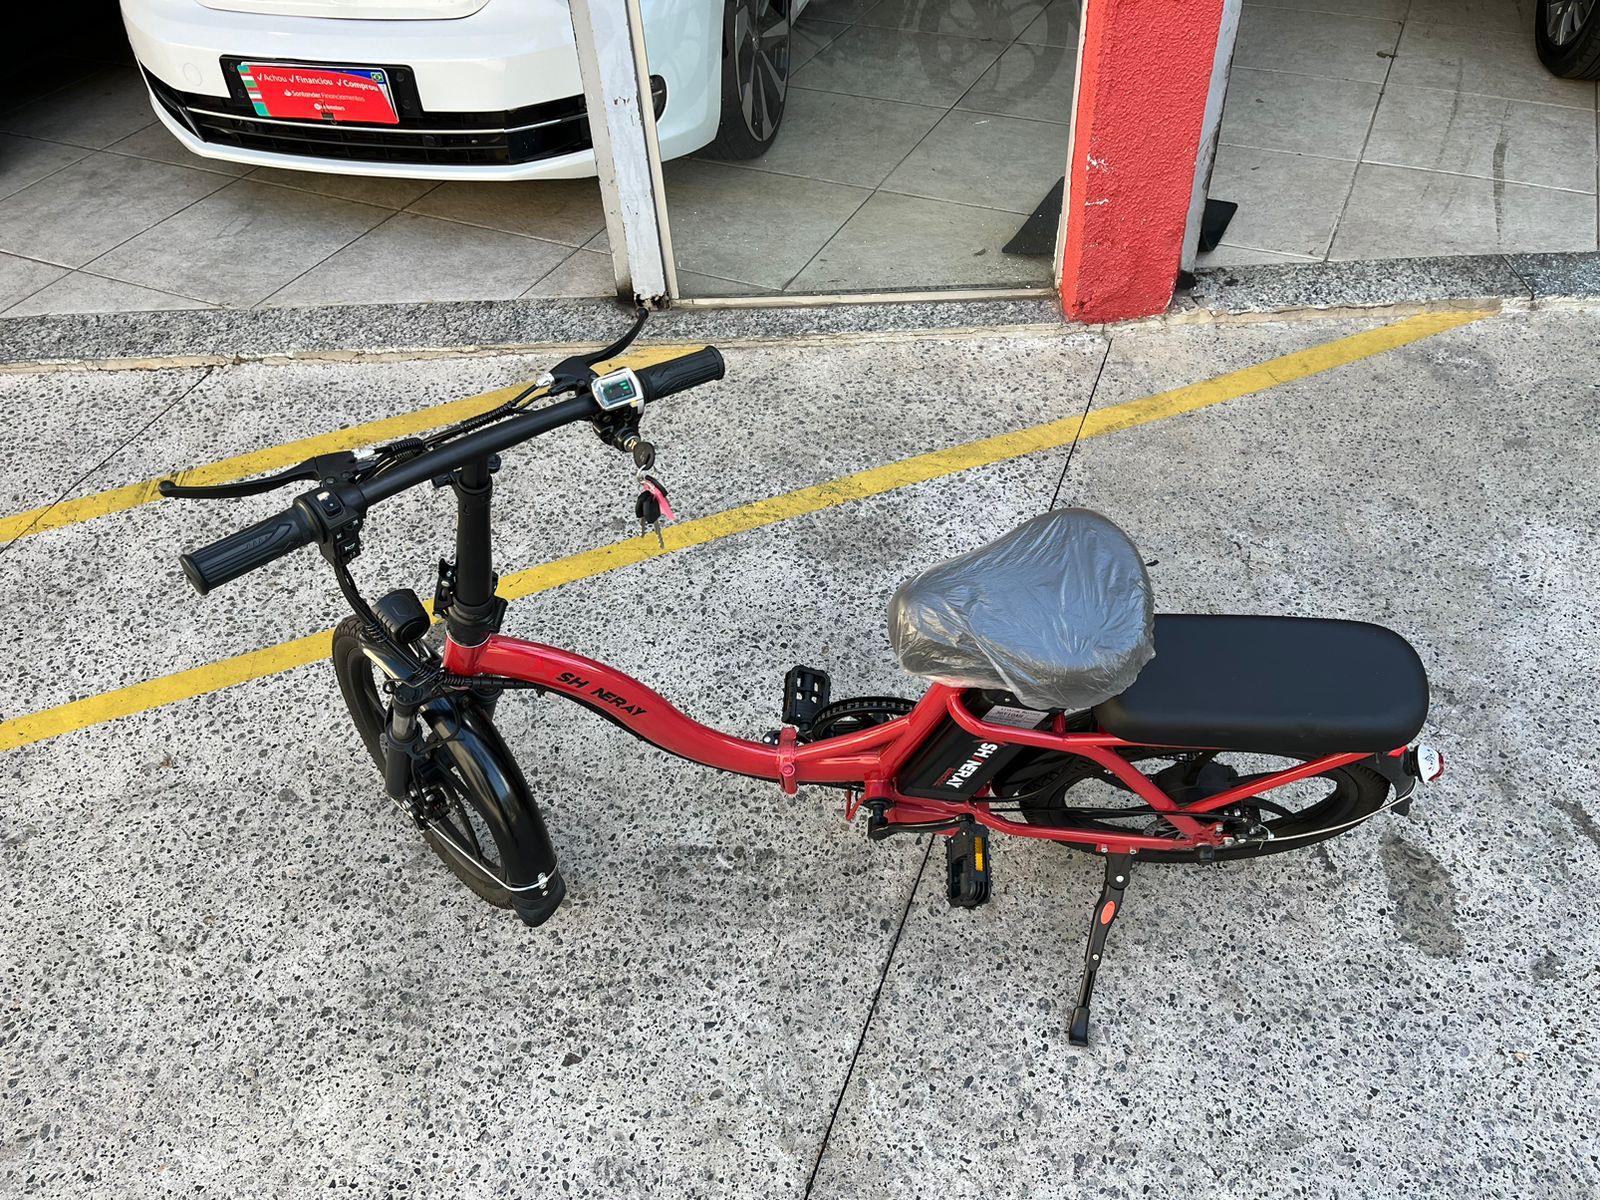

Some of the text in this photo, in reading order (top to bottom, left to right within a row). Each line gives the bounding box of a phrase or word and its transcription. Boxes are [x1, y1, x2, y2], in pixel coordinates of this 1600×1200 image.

[263, 73, 287, 83] Achou
[296, 75, 333, 86] Financiou
[556, 672, 647, 716] SHNERAY
[946, 742, 999, 789] SHINERAY
